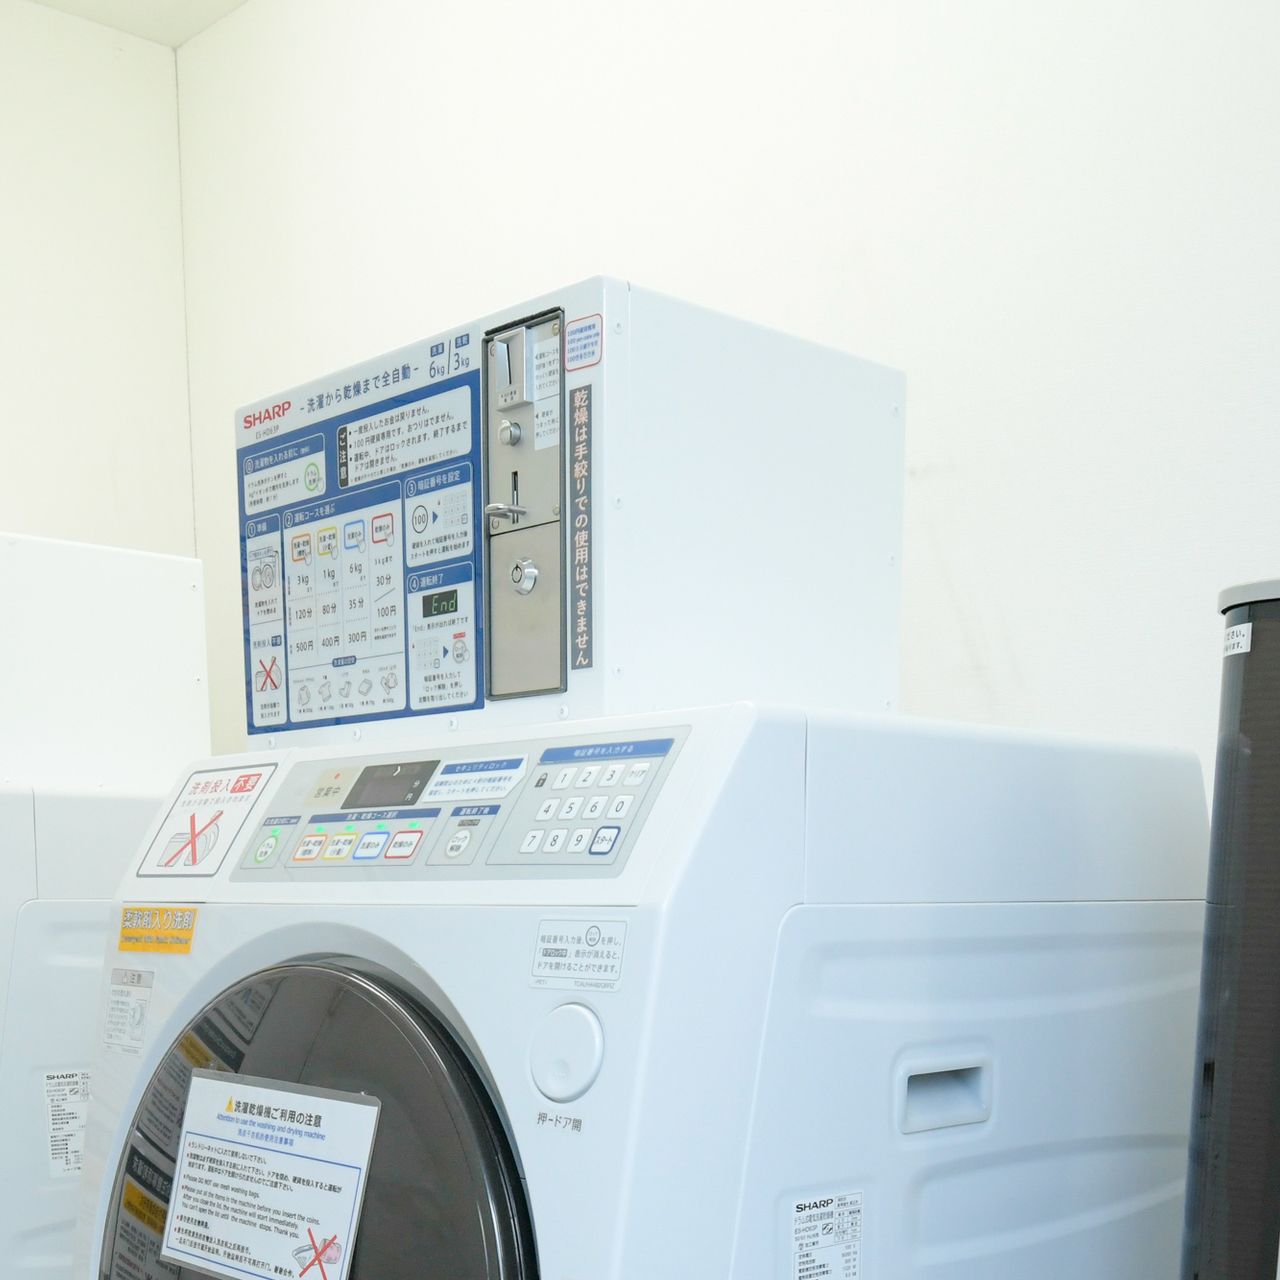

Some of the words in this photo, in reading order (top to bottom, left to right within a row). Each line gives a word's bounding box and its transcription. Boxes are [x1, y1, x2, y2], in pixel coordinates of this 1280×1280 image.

[307, 364, 411, 414] 洗濯から乾燥まで全自動
[429, 360, 445, 378] 6kg
[454, 352, 470, 371] 3kg
[243, 400, 291, 430] SHARP
[414, 512, 426, 526] 100
[573, 389, 589, 666] 乾燥は手絞りでの使用はできません
[376, 574, 391, 586] 30分
[295, 608, 312, 620] 120分
[322, 603, 336, 615] 80分
[377, 605, 396, 618] 100円
[432, 591, 456, 615] End
[296, 640, 313, 652] 500円
[322, 636, 339, 647] 400円
[348, 631, 367, 643] 300円
[560, 773, 567, 783] 1
[583, 771, 592, 783] 2
[606, 770, 616, 781] 3
[544, 803, 551, 815] 4
[566, 802, 574, 814] 5
[590, 801, 599, 812] 6
[528, 836, 536, 846] 7
[550, 835, 558, 847] 8
[576, 834, 583, 846] 9
[124, 908, 192, 932] 柔軟剤入り洗剤
[234, 1100, 322, 1128] 洗濯乾燥機ご利用の注意
[796, 1198, 834, 1213] SHARP
